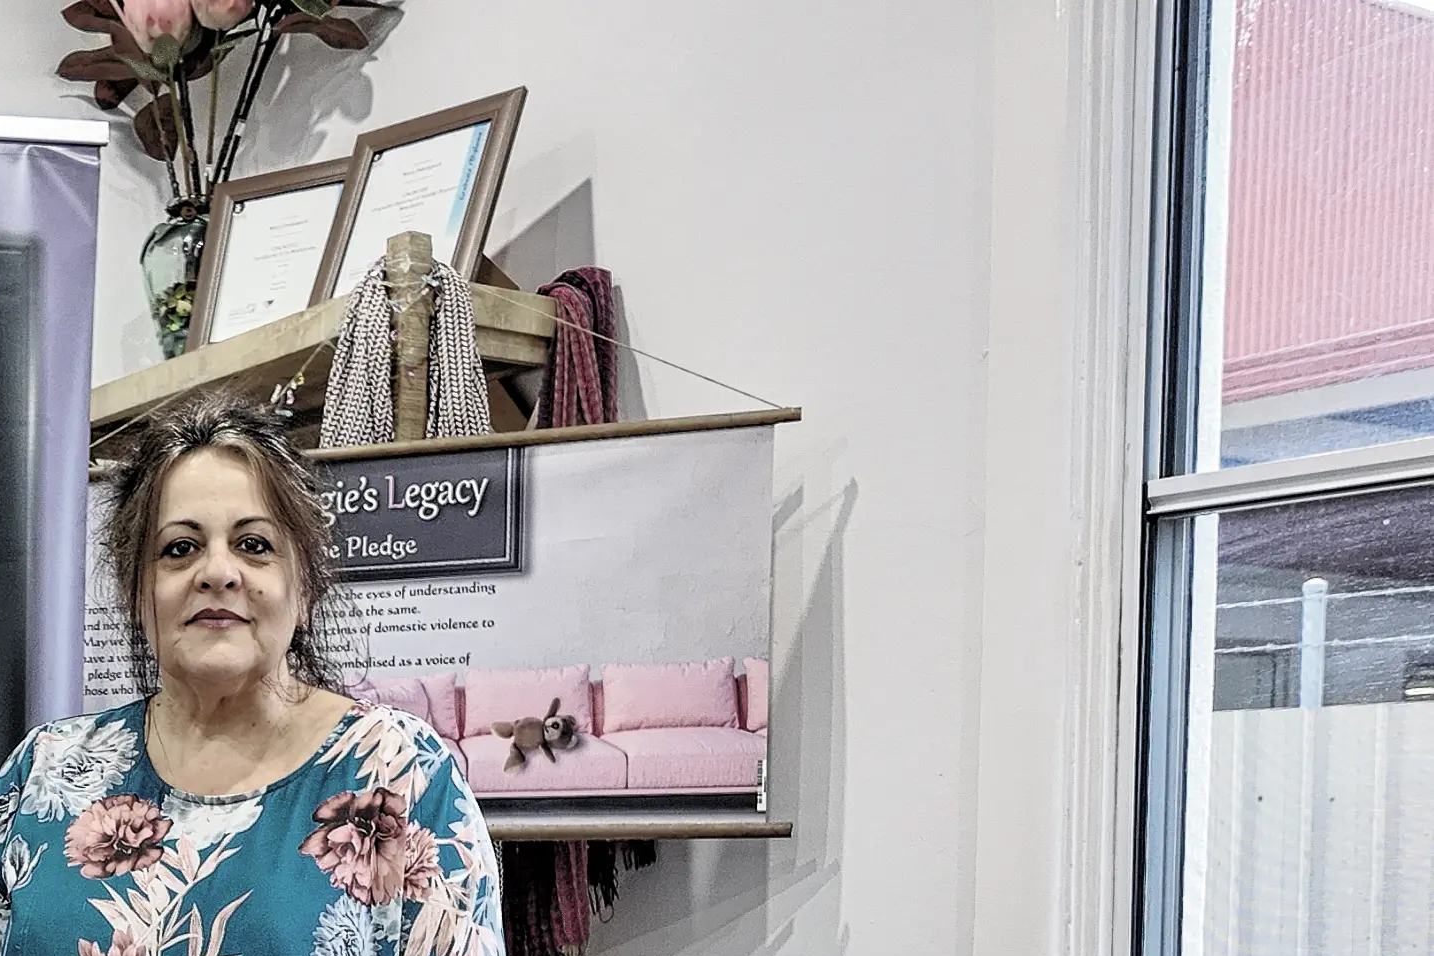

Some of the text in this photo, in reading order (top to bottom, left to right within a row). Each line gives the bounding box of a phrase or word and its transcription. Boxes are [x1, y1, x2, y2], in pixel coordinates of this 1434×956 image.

[320, 475, 489, 528] gie’s Legacy
[346, 534, 418, 560] Pledge
[366, 591, 391, 600] eyes
[394, 586, 406, 600] of
[409, 583, 496, 597] understanding
[349, 607, 363, 617] do
[366, 605, 384, 616] the
[387, 605, 421, 615] same.
[360, 623, 371, 636] of
[374, 620, 427, 634] domestic
[430, 618, 479, 630] violence
[482, 619, 495, 628] to
[88, 668, 122, 681] pledge
[399, 657, 412, 667] as
[415, 658, 422, 666] a
[425, 655, 456, 665] voice
[459, 653, 471, 666] of
[111, 684, 133, 694] who
